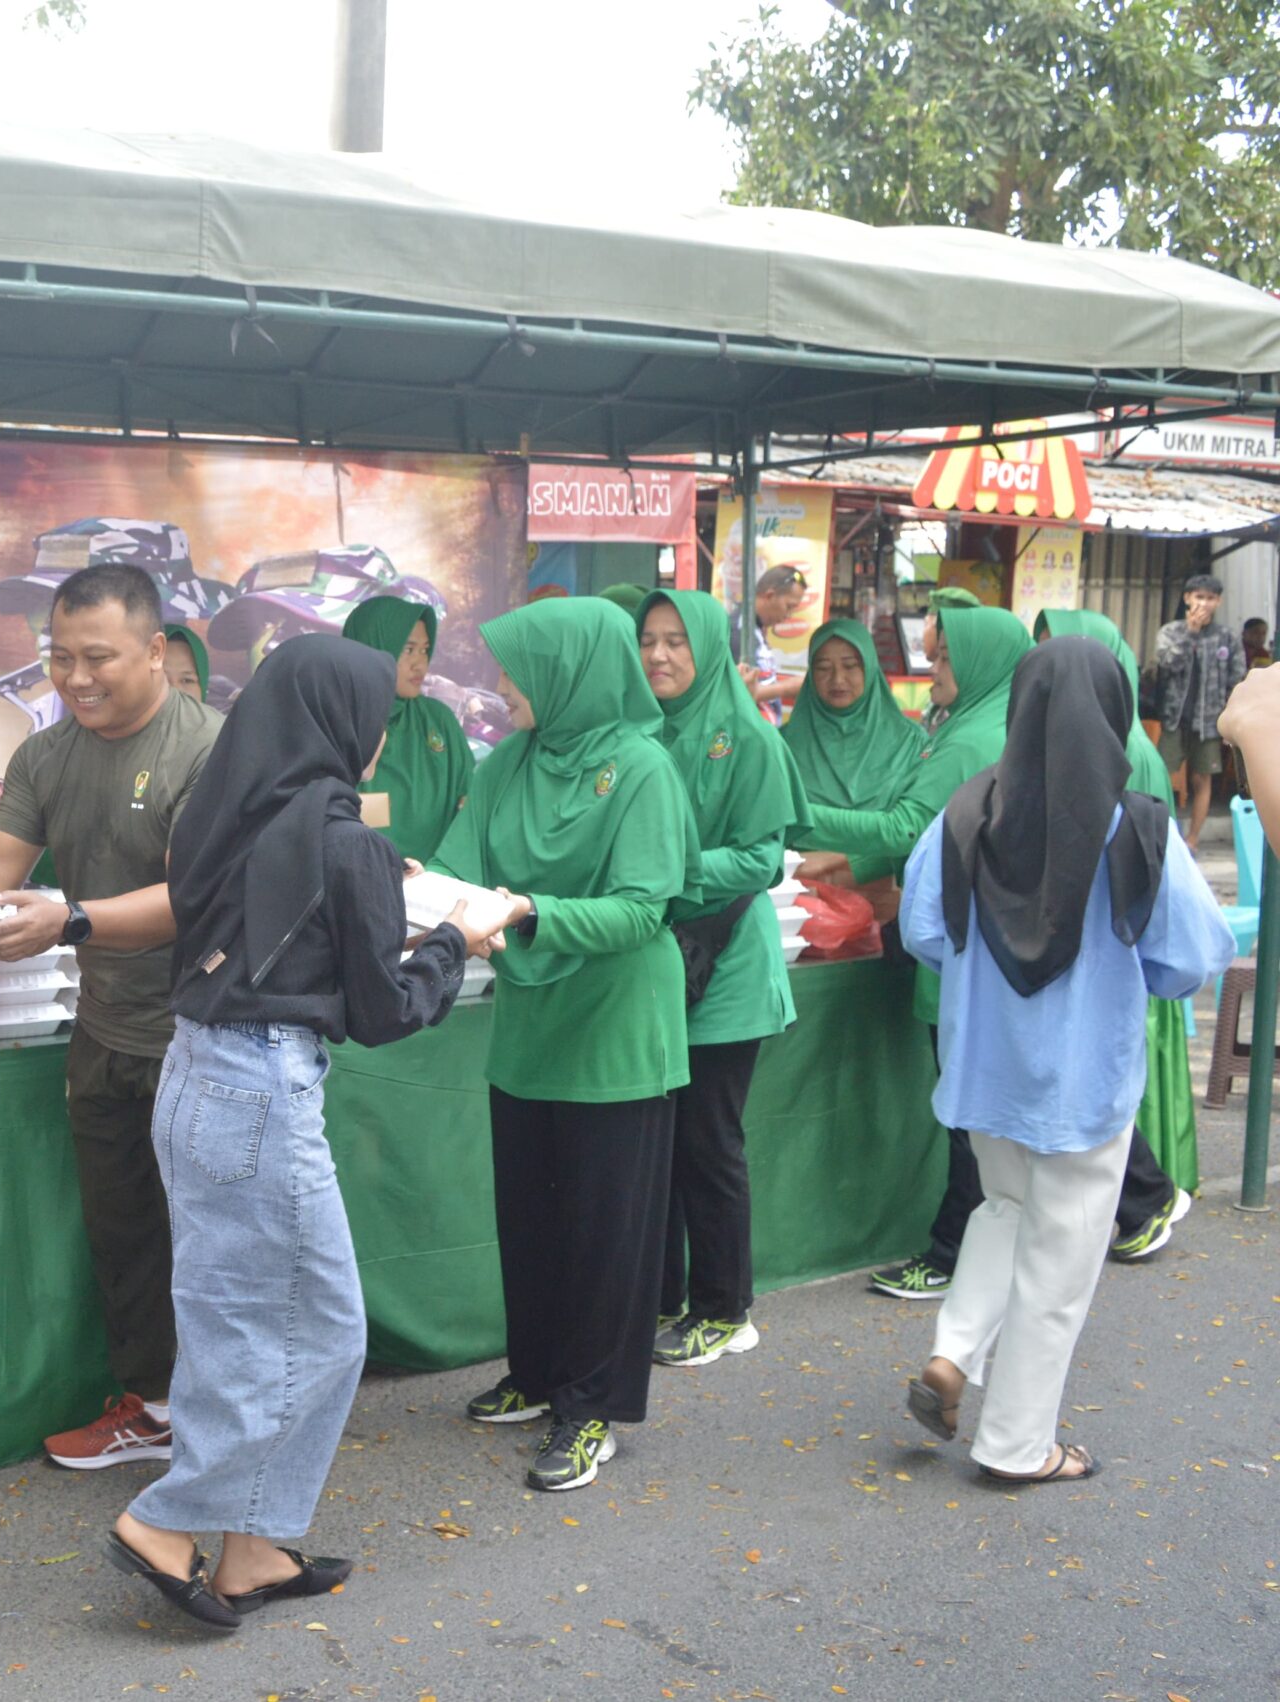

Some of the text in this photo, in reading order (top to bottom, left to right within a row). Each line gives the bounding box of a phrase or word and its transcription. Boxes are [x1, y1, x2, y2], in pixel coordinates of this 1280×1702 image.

[1163, 431, 1205, 453] UKM
[1211, 436, 1267, 458] MITRA
[982, 461, 1039, 491] POCI
